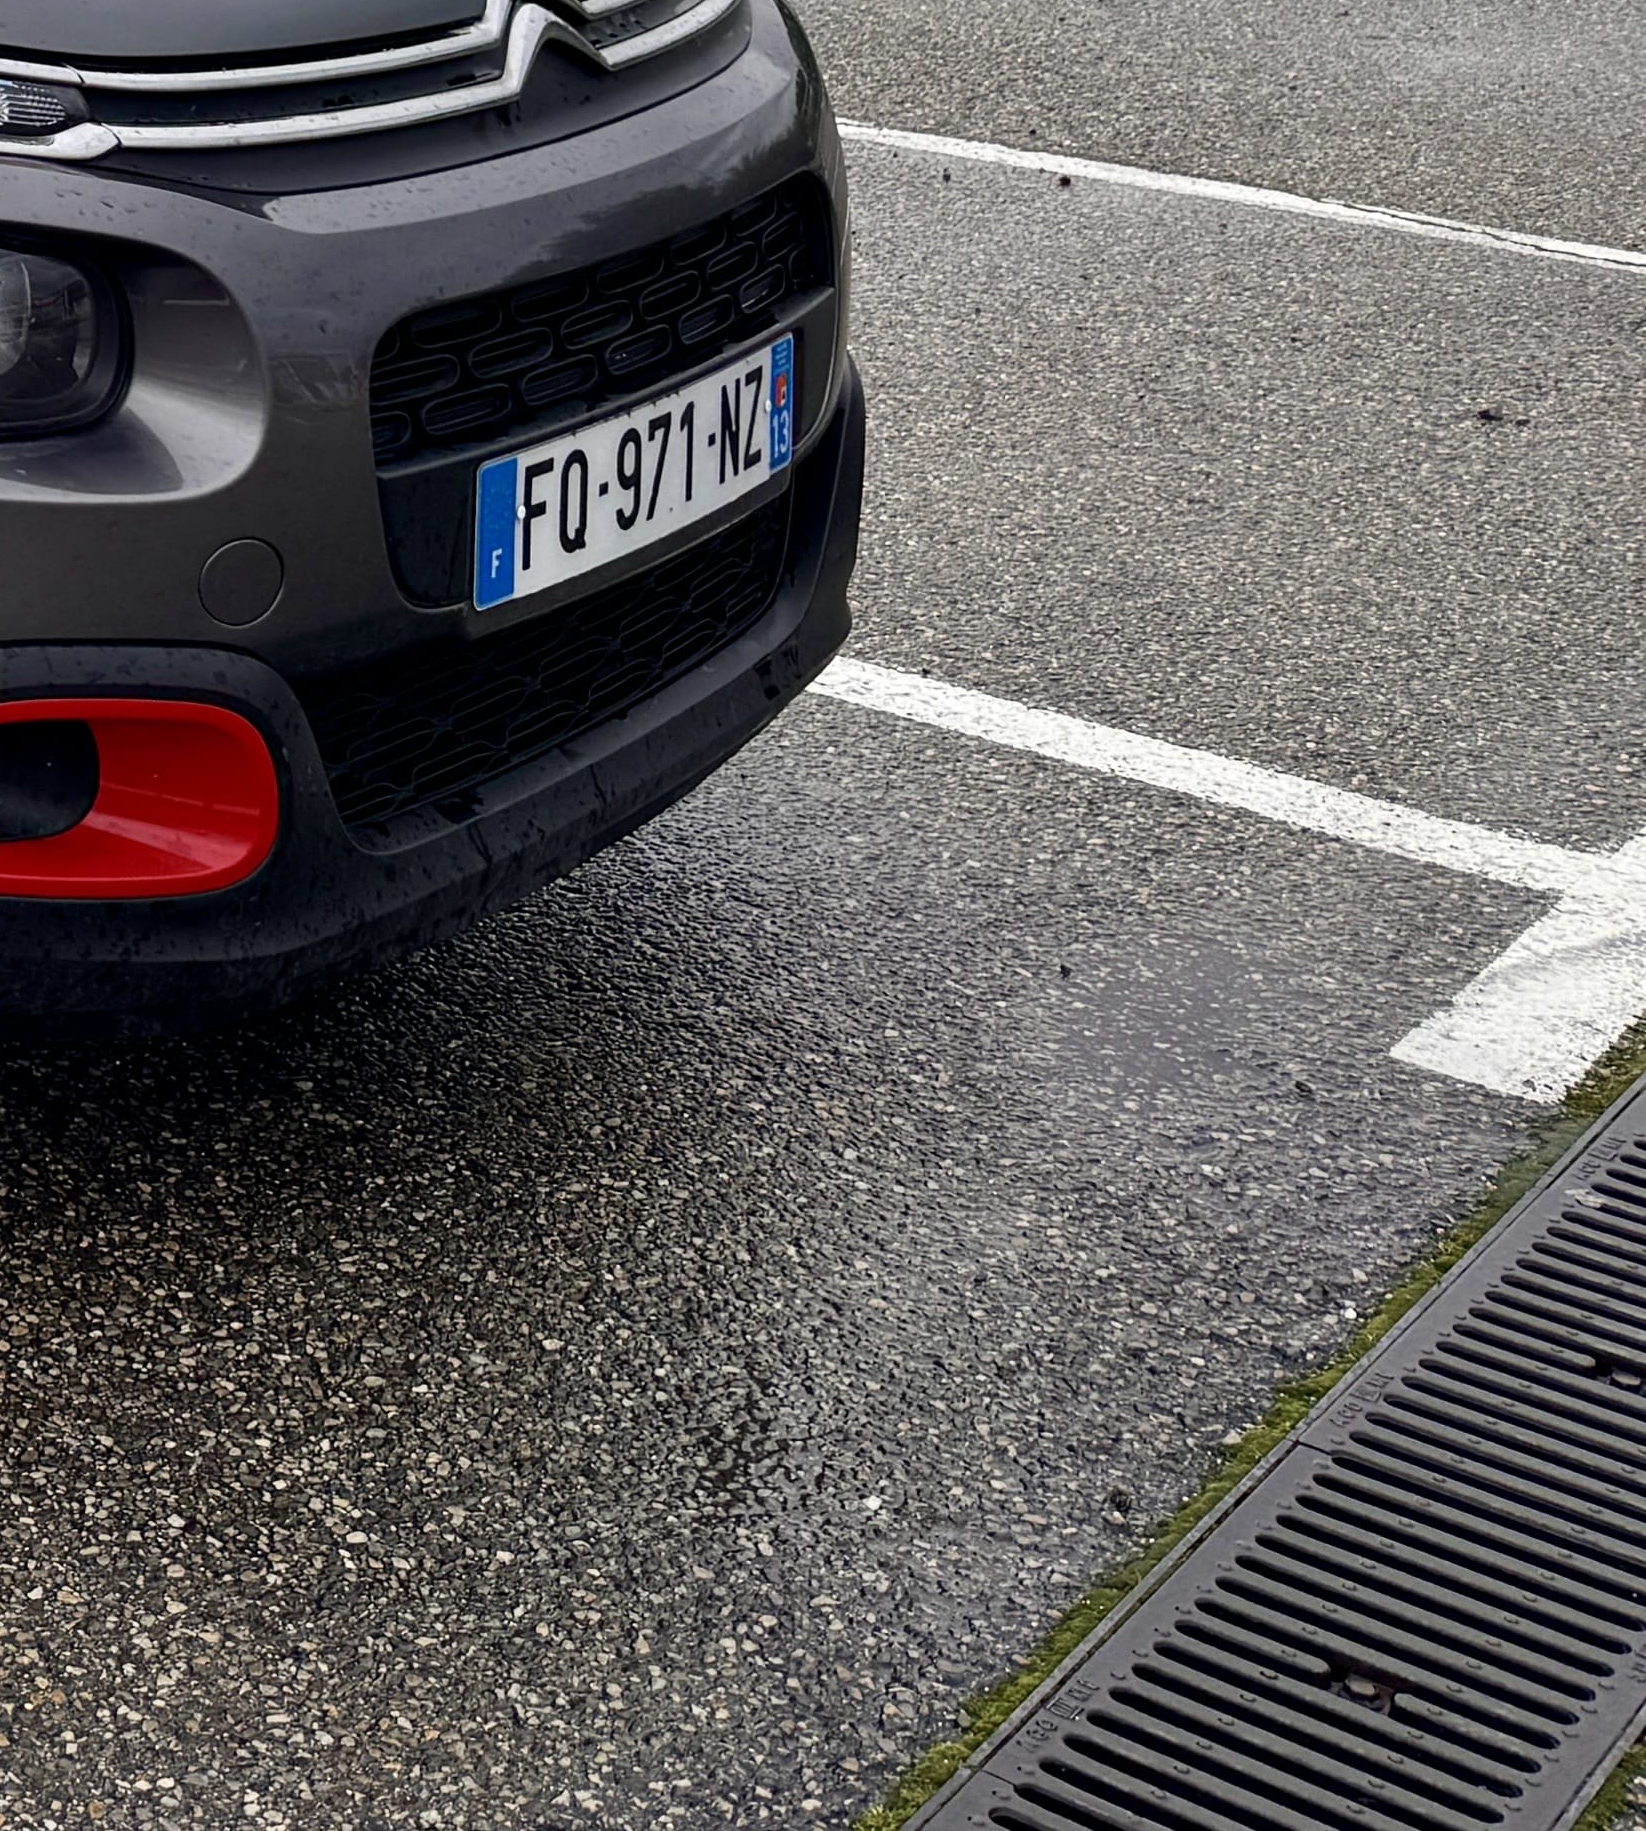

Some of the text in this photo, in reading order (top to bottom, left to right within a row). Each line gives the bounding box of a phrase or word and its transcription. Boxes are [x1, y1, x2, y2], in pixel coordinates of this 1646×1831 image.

[490, 365, 789, 578] F FQ-971-NZ 13
